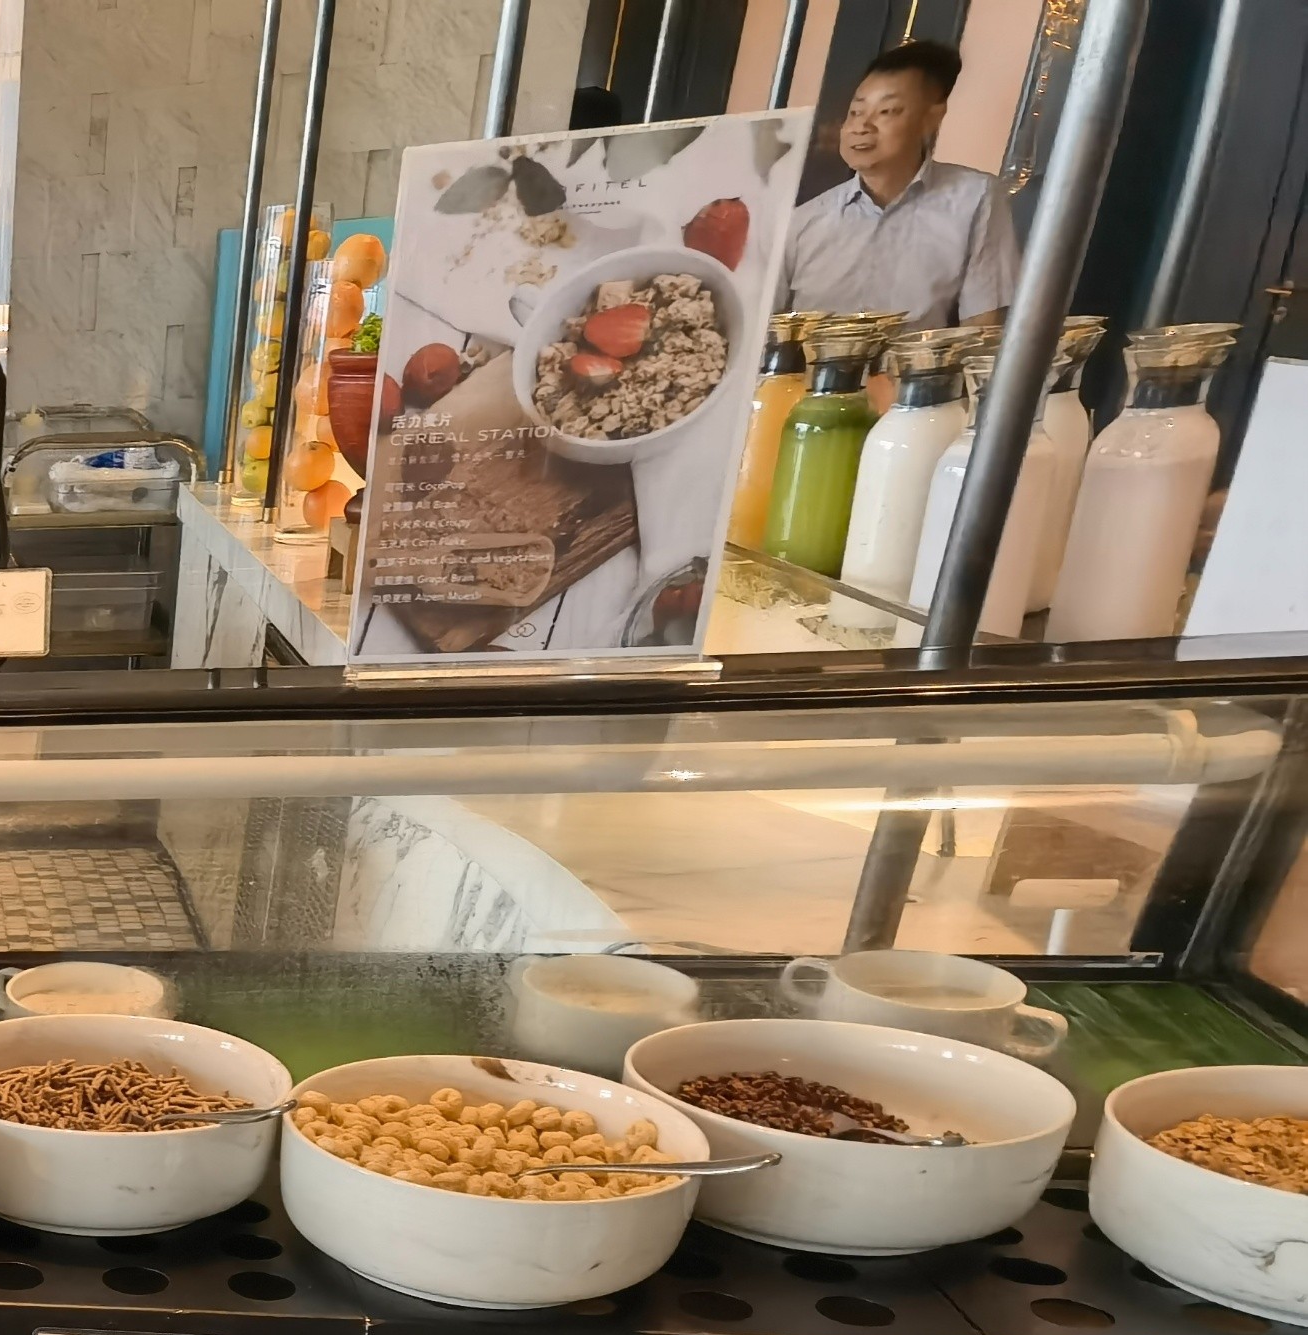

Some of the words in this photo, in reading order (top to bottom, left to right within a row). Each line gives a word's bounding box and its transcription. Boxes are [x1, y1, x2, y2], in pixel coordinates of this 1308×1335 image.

[562, 178, 647, 194] FITEL
[390, 432, 469, 446] CEREAL
[478, 426, 565, 442] STATION
